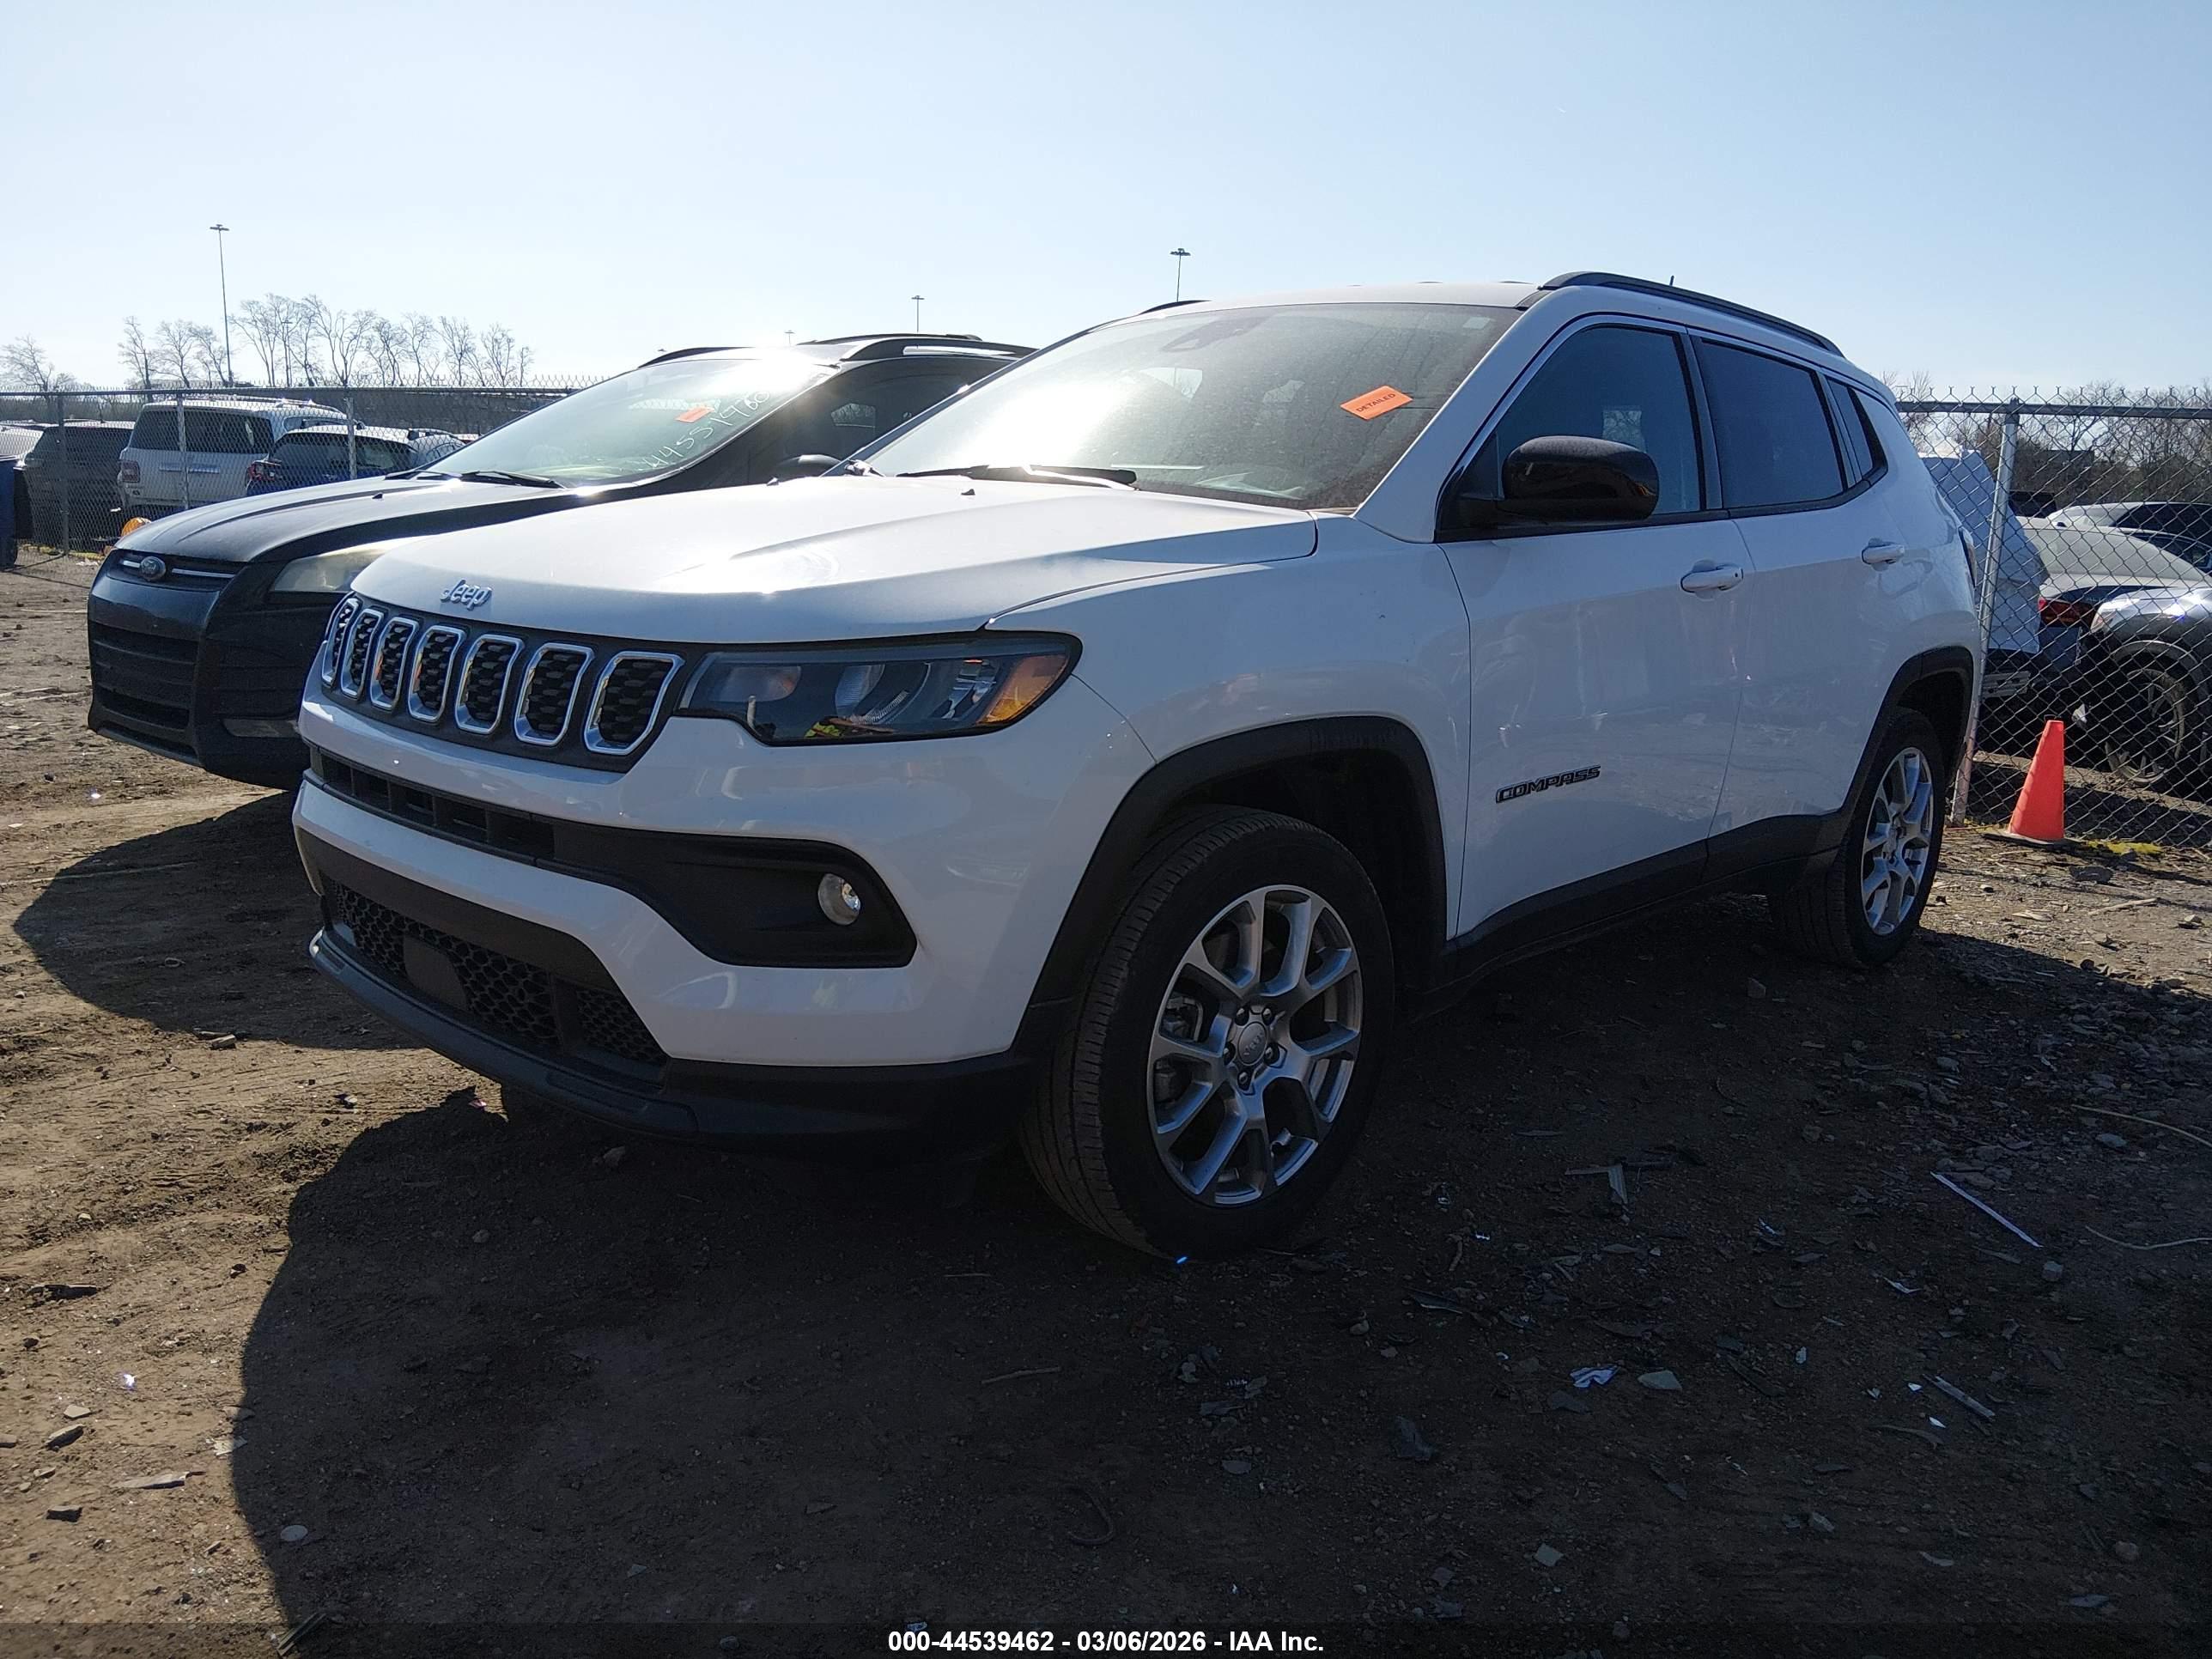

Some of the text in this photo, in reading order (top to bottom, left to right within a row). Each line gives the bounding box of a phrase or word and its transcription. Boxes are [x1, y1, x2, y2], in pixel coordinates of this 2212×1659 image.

[1355, 392, 1396, 413] DETAILED
[440, 578, 493, 611] Jeep
[1495, 764, 1601, 804] COMPASS
